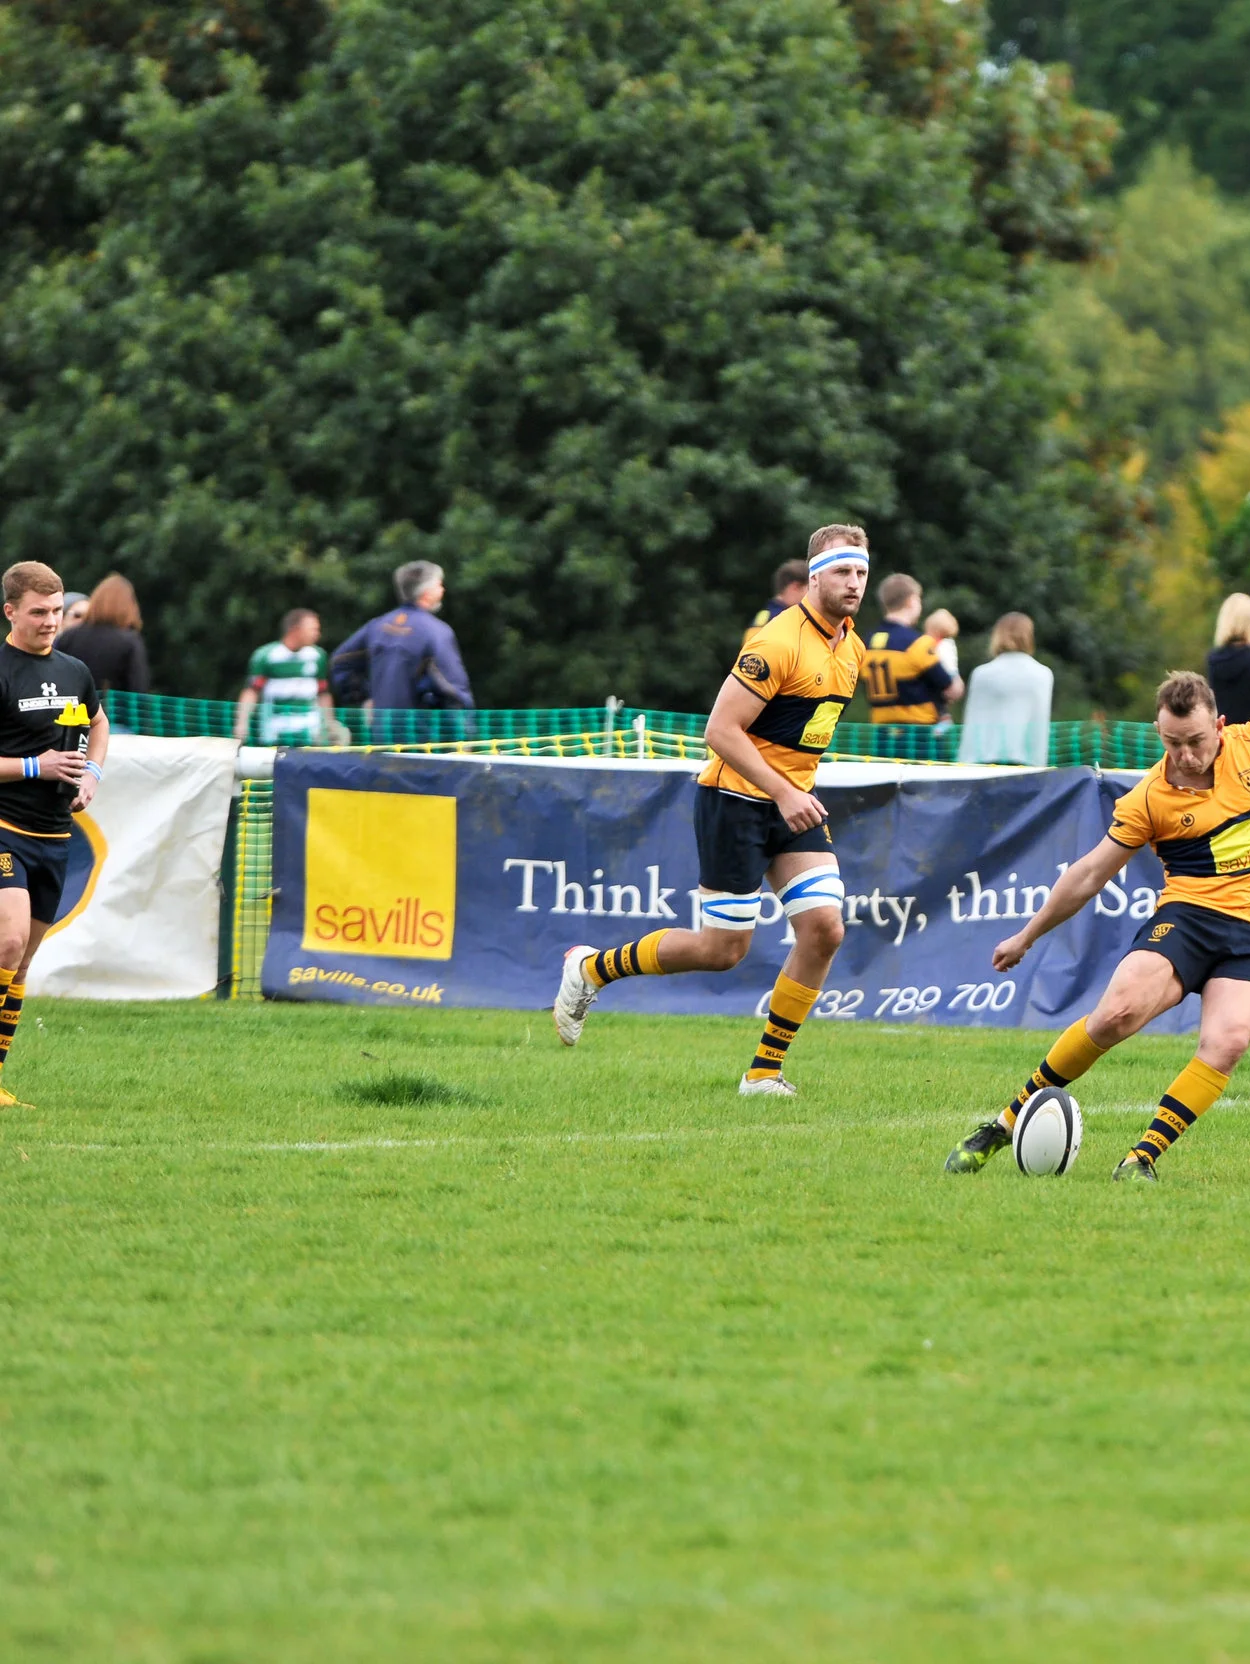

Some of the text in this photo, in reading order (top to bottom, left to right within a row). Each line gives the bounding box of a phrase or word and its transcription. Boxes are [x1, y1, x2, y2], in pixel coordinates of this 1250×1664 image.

[867, 659, 894, 695] 11
[503, 858, 678, 919] Think
[948, 861, 1069, 923] thin
[314, 897, 445, 947] savills
[288, 966, 445, 1004] savills.co.uk
[873, 985, 942, 1018] 789
[948, 980, 1016, 1012] 700
